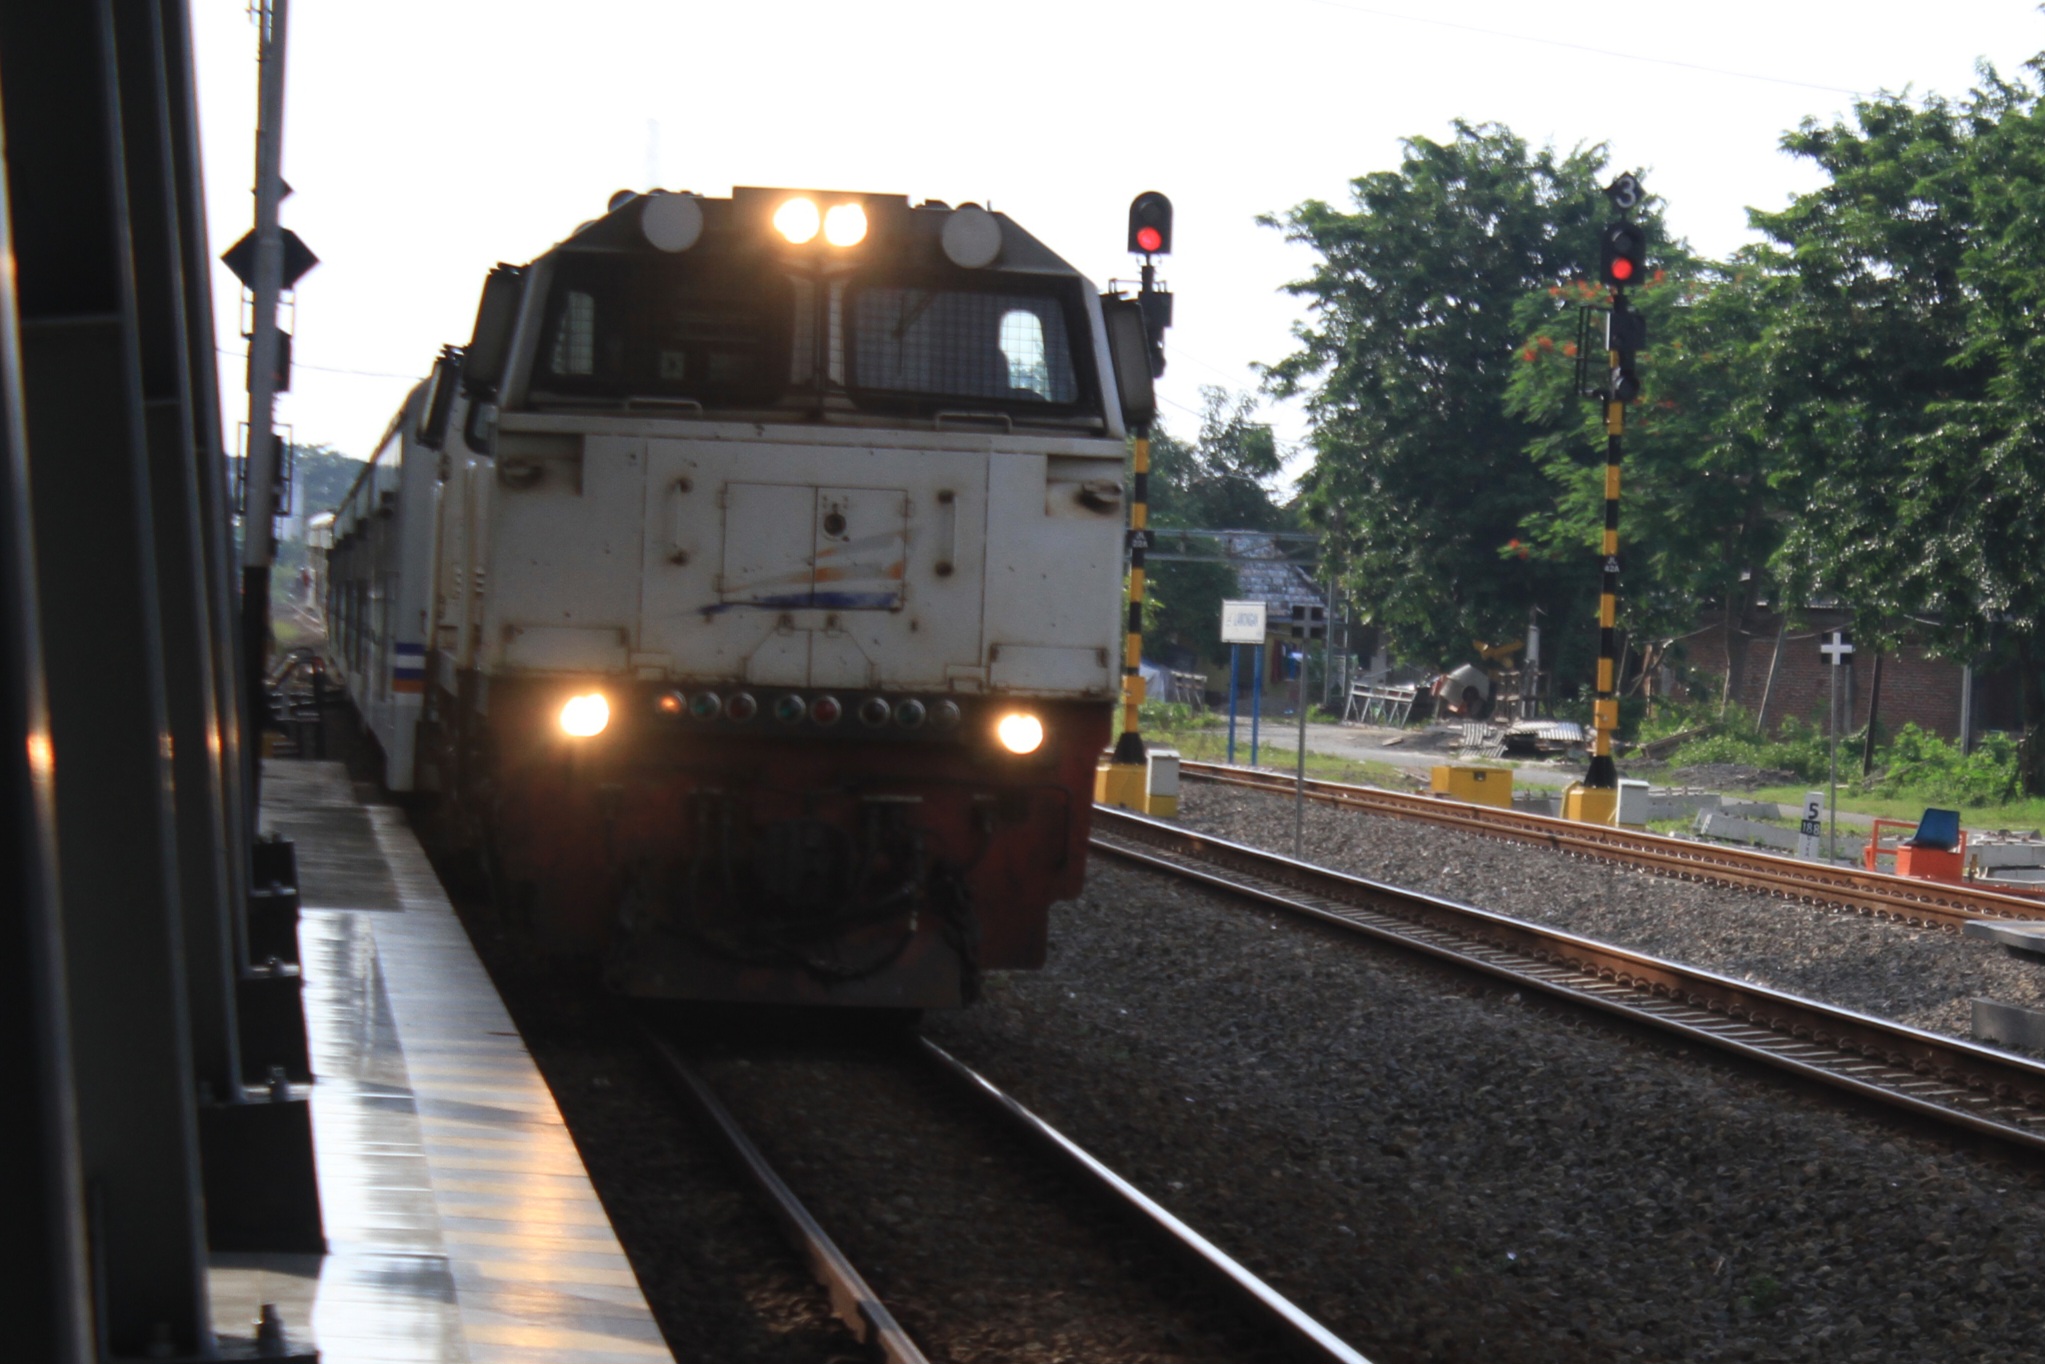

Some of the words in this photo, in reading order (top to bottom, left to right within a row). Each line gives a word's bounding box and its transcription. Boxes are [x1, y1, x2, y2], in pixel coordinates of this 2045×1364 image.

[1616, 176, 1636, 208] 3
[1808, 802, 1819, 820] 5
[1802, 821, 1820, 836] 188
